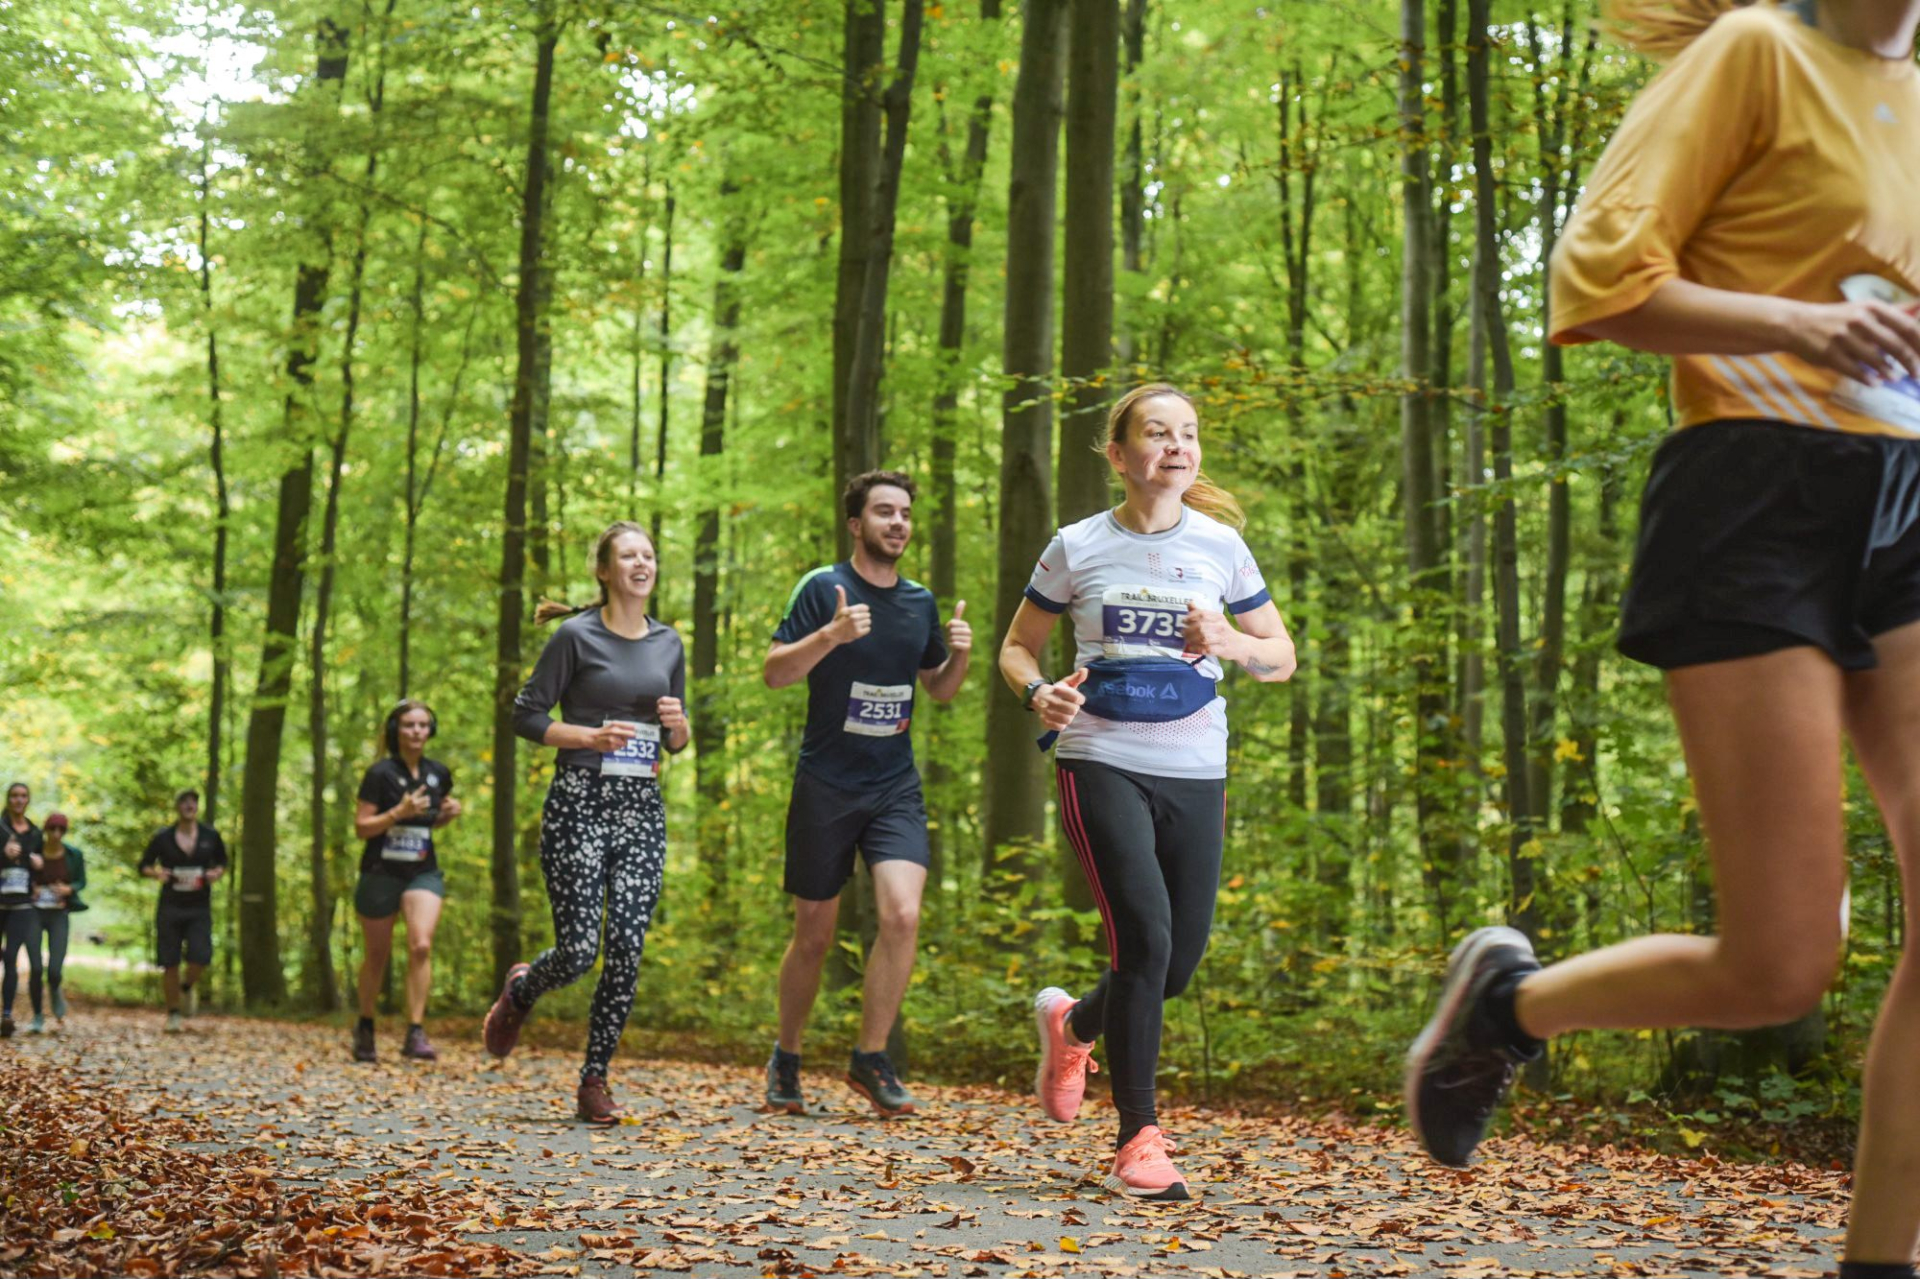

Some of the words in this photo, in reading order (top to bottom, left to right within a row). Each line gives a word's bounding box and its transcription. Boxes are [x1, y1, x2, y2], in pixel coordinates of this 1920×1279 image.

[1120, 592, 1143, 602] TRAIL
[1117, 608, 1187, 638] 3735
[860, 701, 902, 720] 2531
